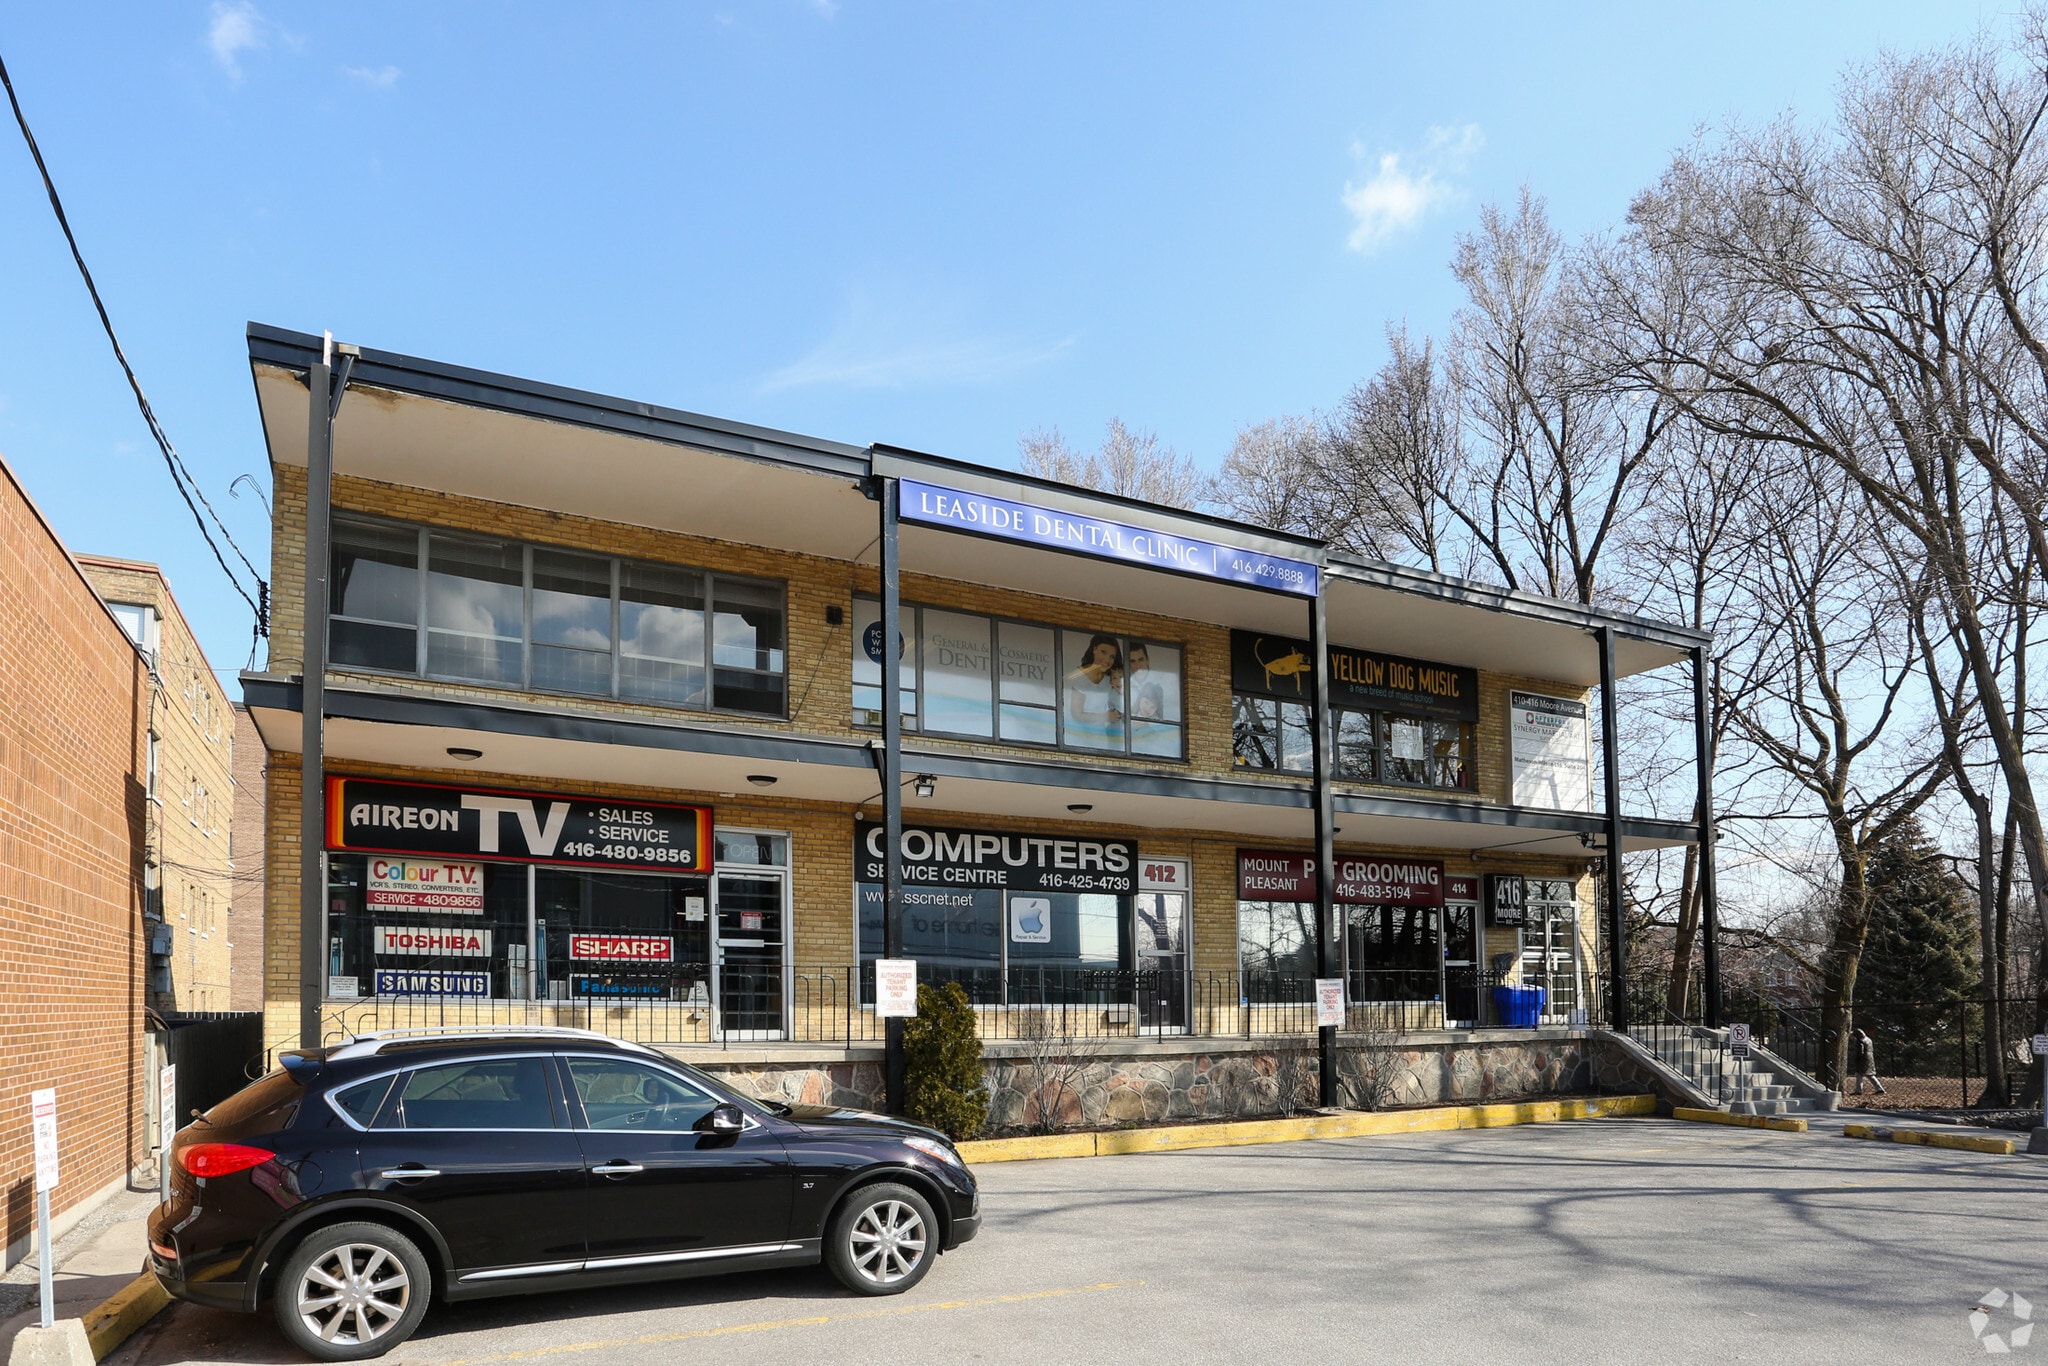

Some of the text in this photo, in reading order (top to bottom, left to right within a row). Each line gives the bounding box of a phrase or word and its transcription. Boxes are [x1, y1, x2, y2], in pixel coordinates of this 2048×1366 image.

[920, 492, 1304, 584] LEASIDE DENTAL CLINIC 416.429.8888
[938, 648, 1048, 681] DENTISTRY
[1331, 653, 1460, 698] YELLOW DOG MUSIC
[1349, 684, 1434, 704] a new breed of music school
[1514, 696, 1584, 714] 410-416 Moore Avenue
[1514, 724, 1541, 734] SYNERGY
[350, 794, 571, 856] AIREON TV
[598, 808, 654, 826] SALES
[598, 825, 670, 844] SERVICE
[563, 842, 692, 864] 416-480-9856
[373, 860, 477, 884] Colour T.V.
[866, 863, 1007, 884] SEVICE CENTRE
[1144, 864, 1176, 883] 412
[1244, 858, 1290, 872] MOUNT
[1342, 861, 1439, 885] GROOMING
[392, 883, 419, 891] STEREO,
[421, 884, 465, 894] CONVERTERS,
[1039, 873, 1130, 890] 416-425-4739
[1244, 876, 1298, 890] PLEASANT
[1452, 883, 1467, 894] 414
[374, 892, 416, 905] SERVICE
[865, 891, 973, 906] ww.sscnet.net
[1336, 883, 1411, 899] 416-483-5194
[1496, 880, 1520, 906] 416
[1497, 908, 1522, 918] MOORE
[384, 934, 481, 950] TOSHIBA
[576, 940, 667, 956] SHARP
[382, 975, 484, 992] SAMSUNG
